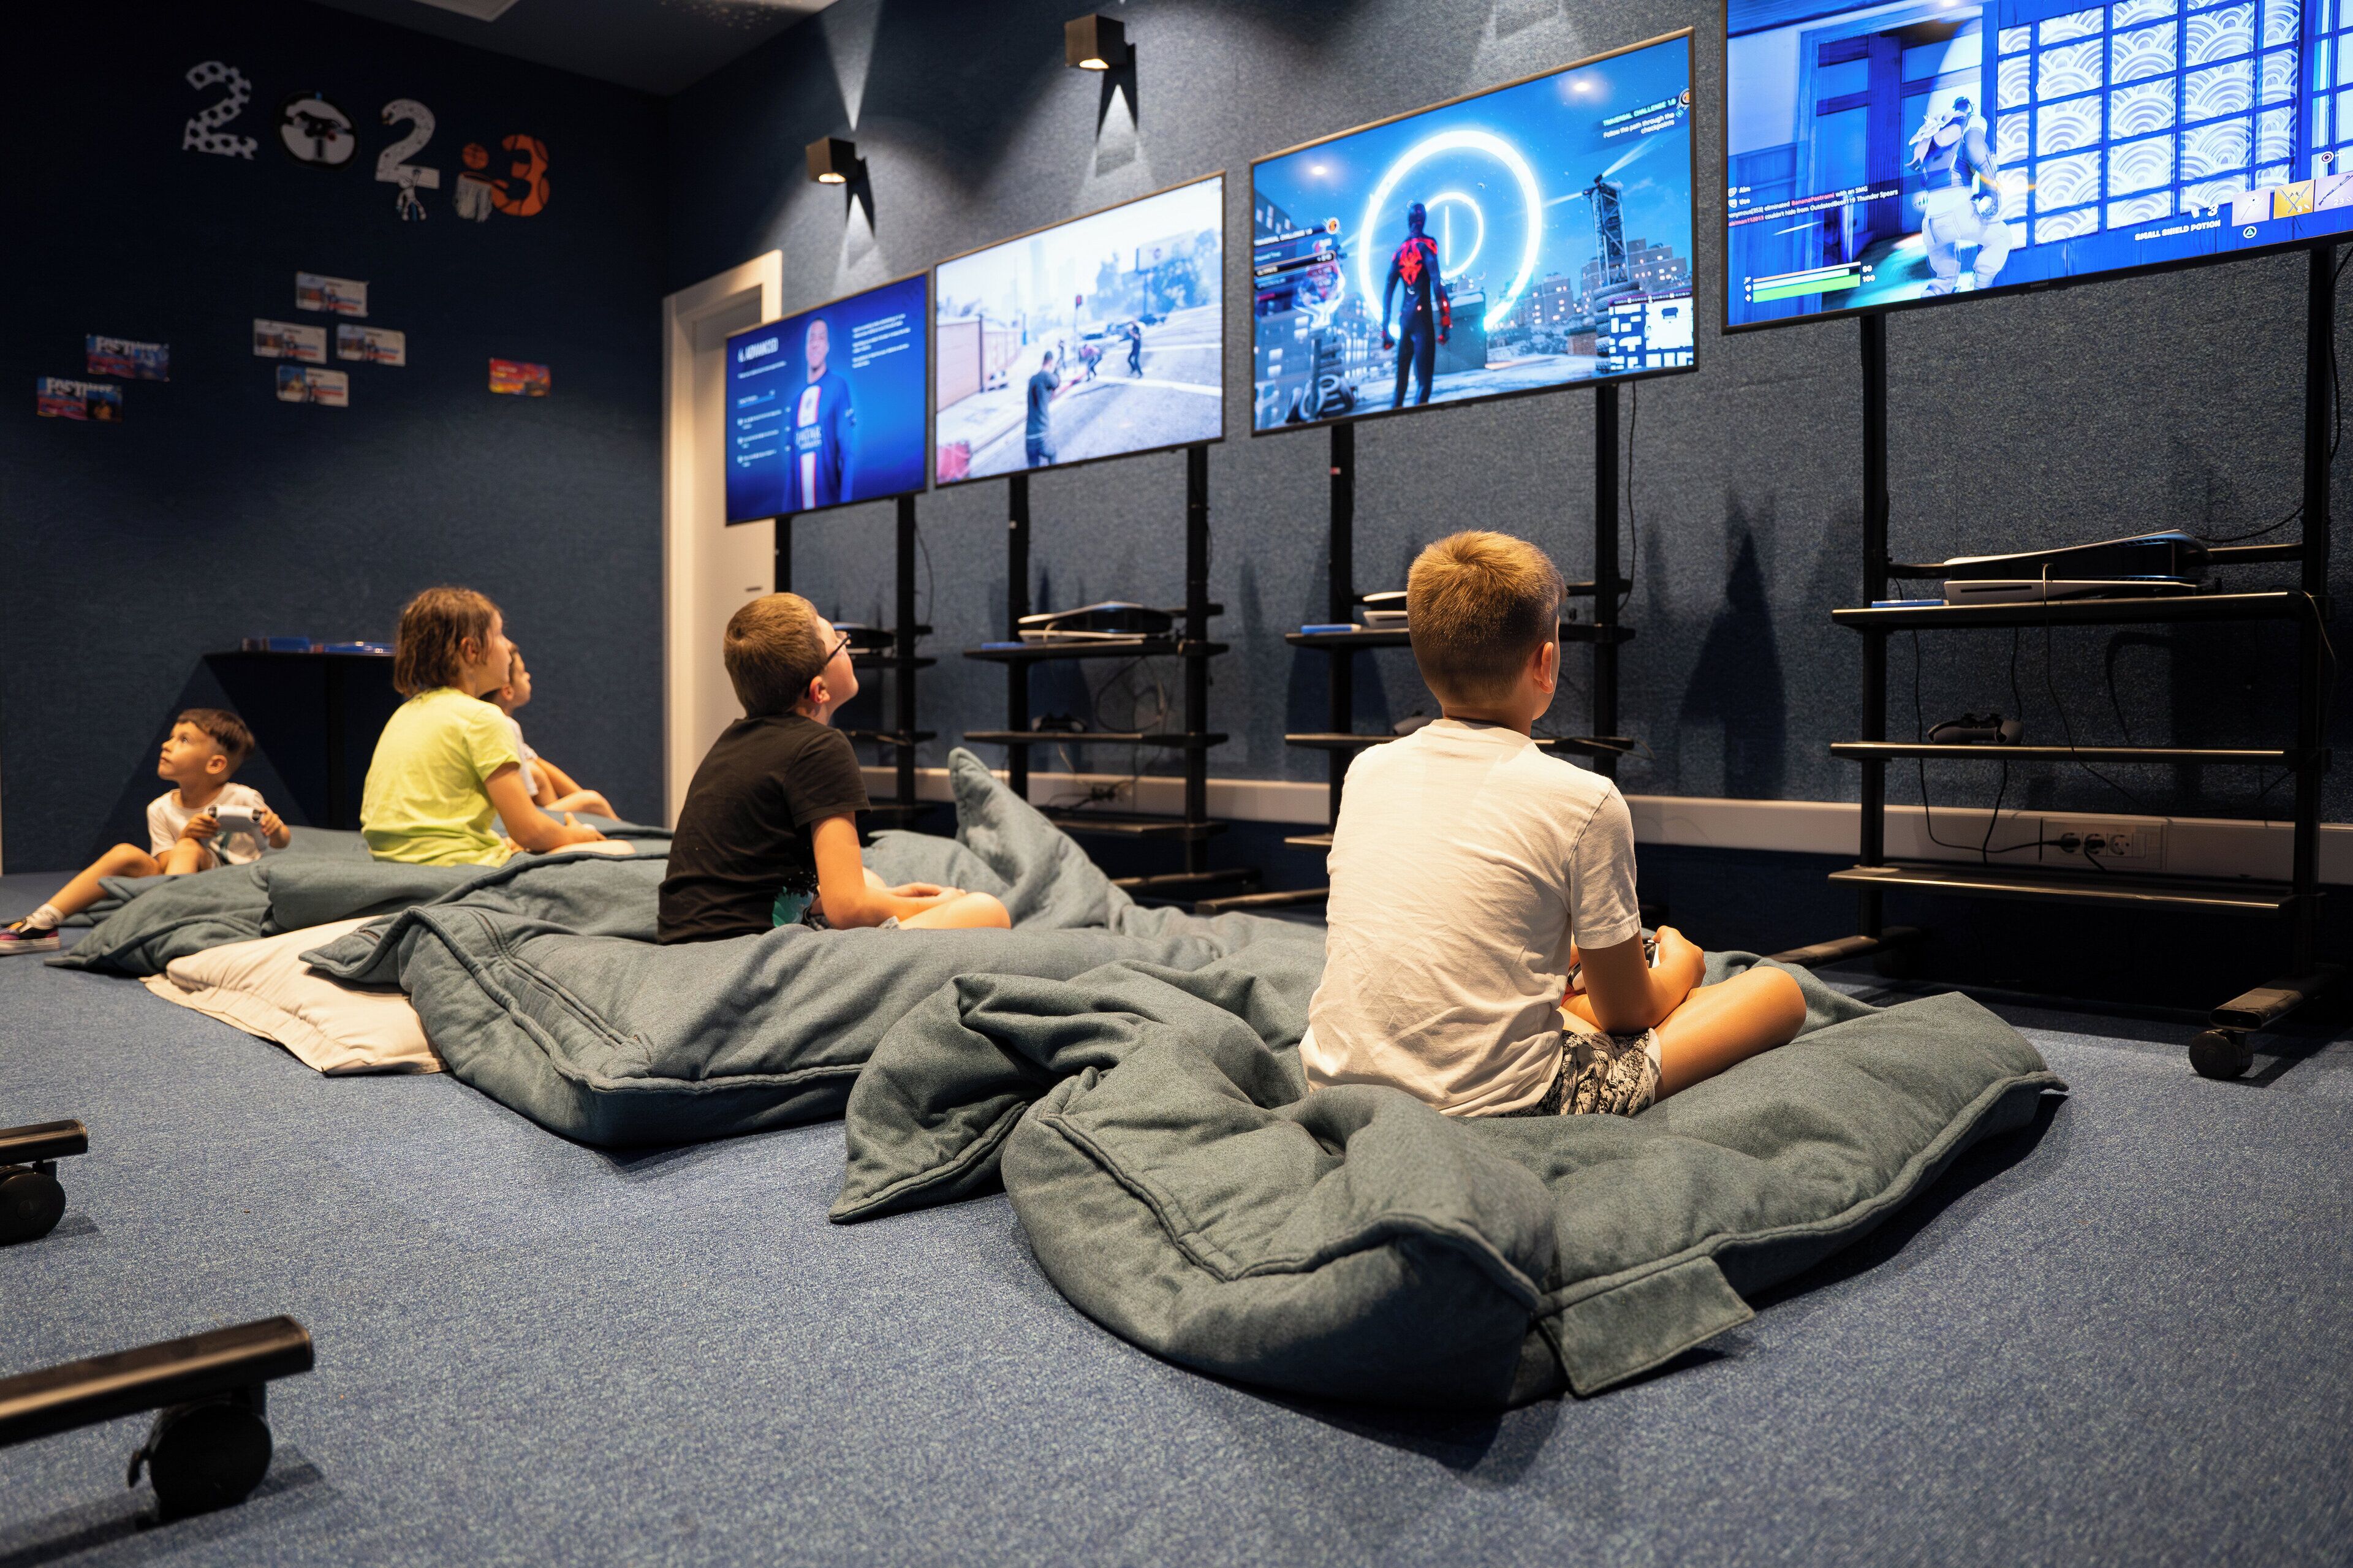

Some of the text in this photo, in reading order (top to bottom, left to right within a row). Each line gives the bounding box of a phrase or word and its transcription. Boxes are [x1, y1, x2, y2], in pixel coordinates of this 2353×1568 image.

[1602, 112, 1633, 126] TRAVERSAL
[1634, 101, 1667, 117] CHALLENGE
[1603, 129, 1620, 138] Follow
[1629, 122, 1642, 132] path
[1642, 115, 1665, 127] through
[1640, 119, 1675, 134] checkpoints
[1764, 201, 1790, 211] eliminated
[1765, 211, 1785, 220] couldn't
[1857, 193, 1880, 202] Thunder
[1880, 189, 1898, 199] Spears
[2207, 203, 2219, 217] 3
[2134, 219, 2221, 241] SMALL SHIELD POTION
[1862, 275, 1876, 283] 100
